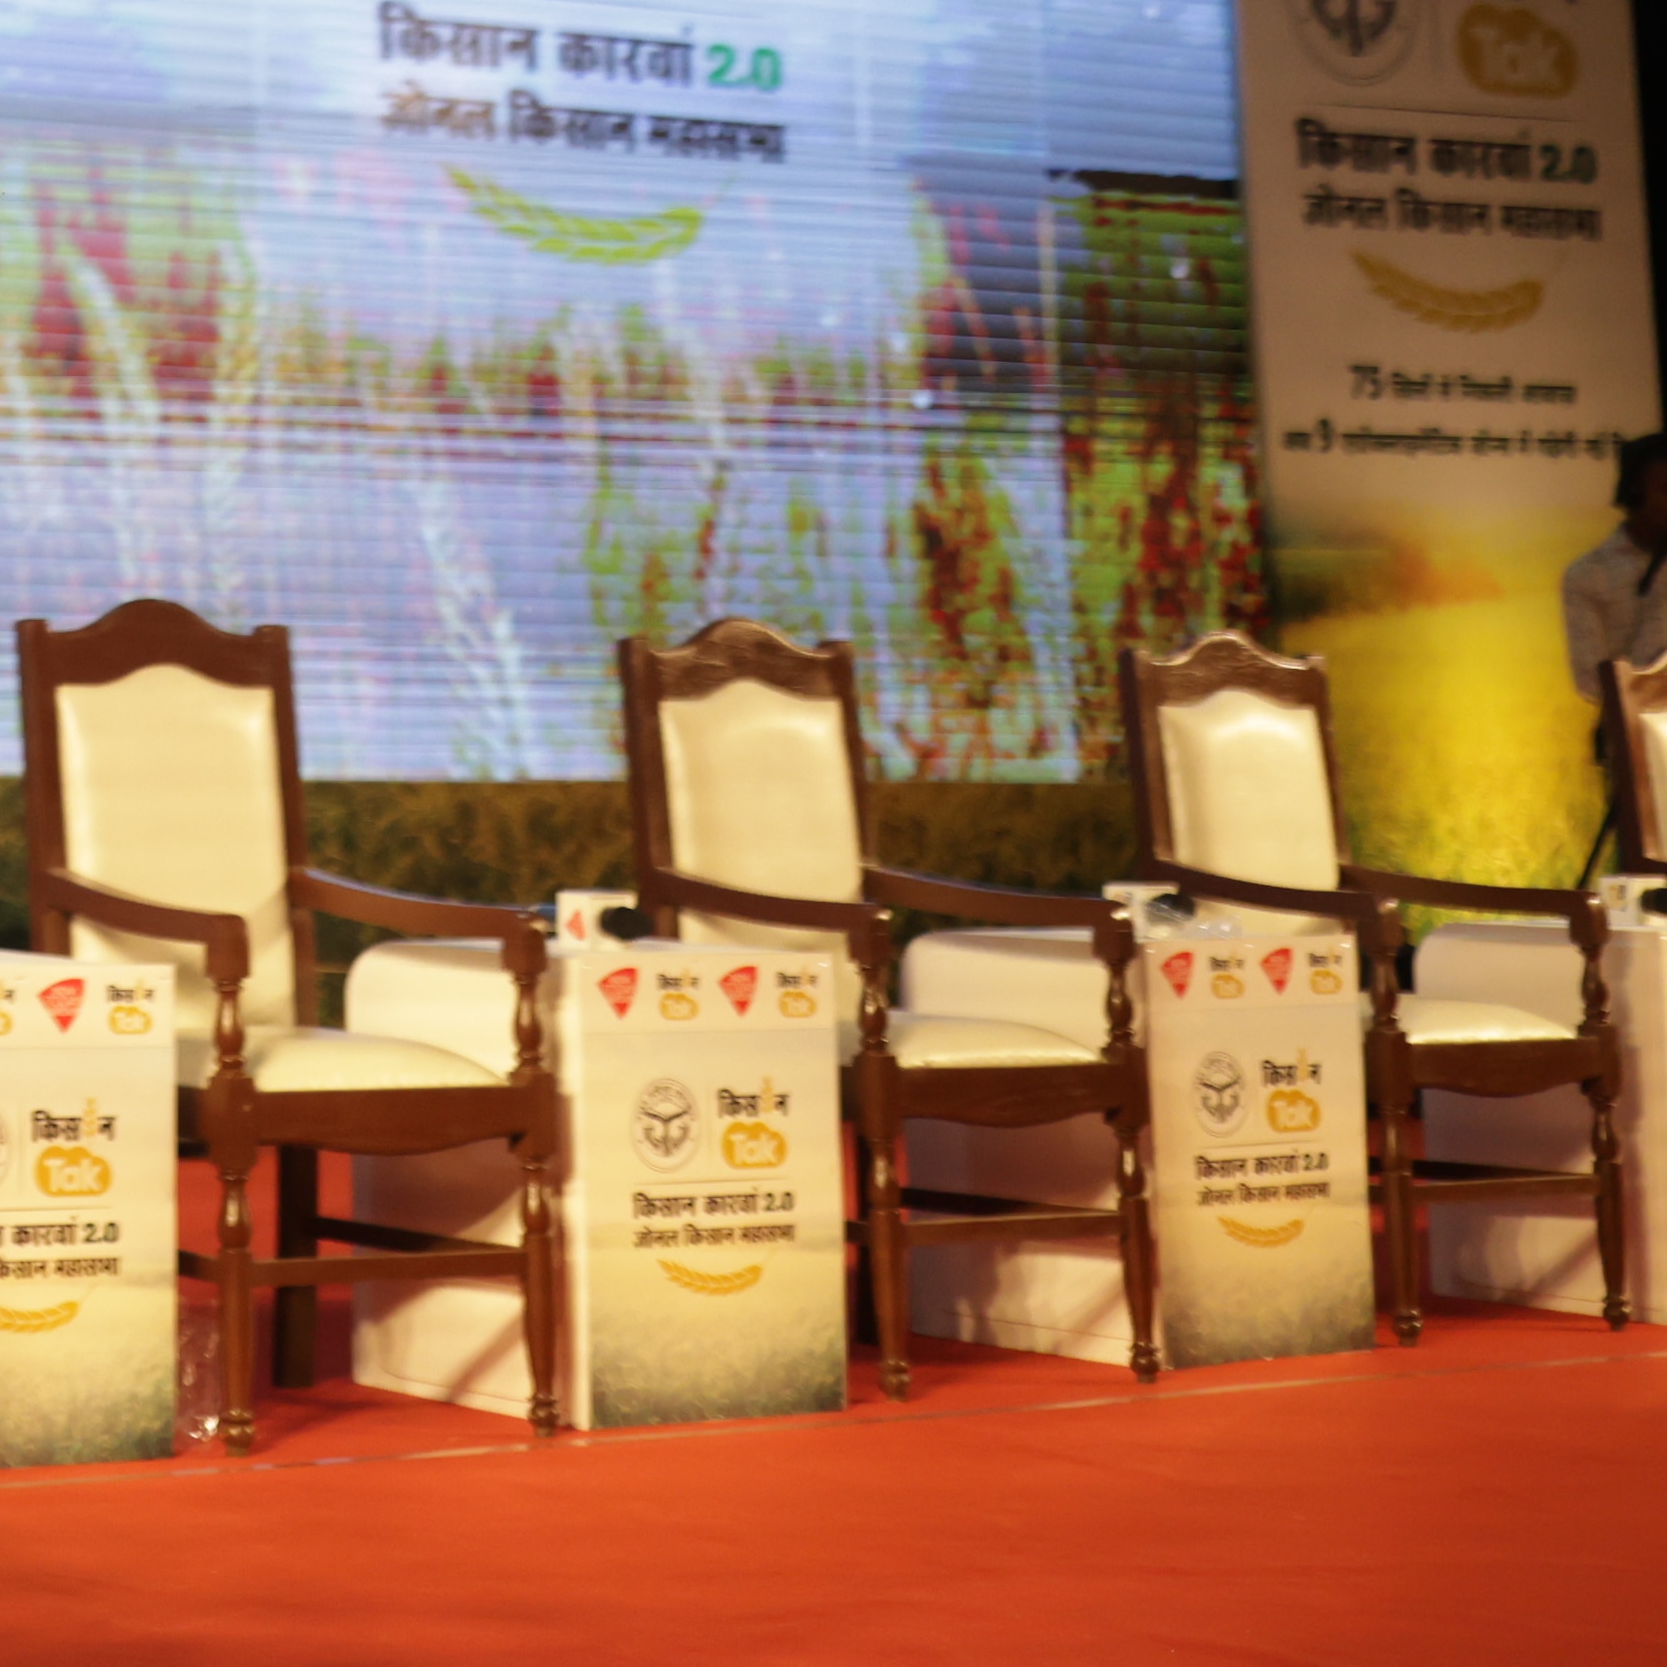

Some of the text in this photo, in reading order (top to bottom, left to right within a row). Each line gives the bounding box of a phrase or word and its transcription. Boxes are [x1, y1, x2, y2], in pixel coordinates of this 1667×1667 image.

[379, 0, 537, 71] किसान
[706, 45, 782, 91] 2.0
[45, 1158, 101, 1192] Tak
[83, 1223, 119, 1244] 2.0
